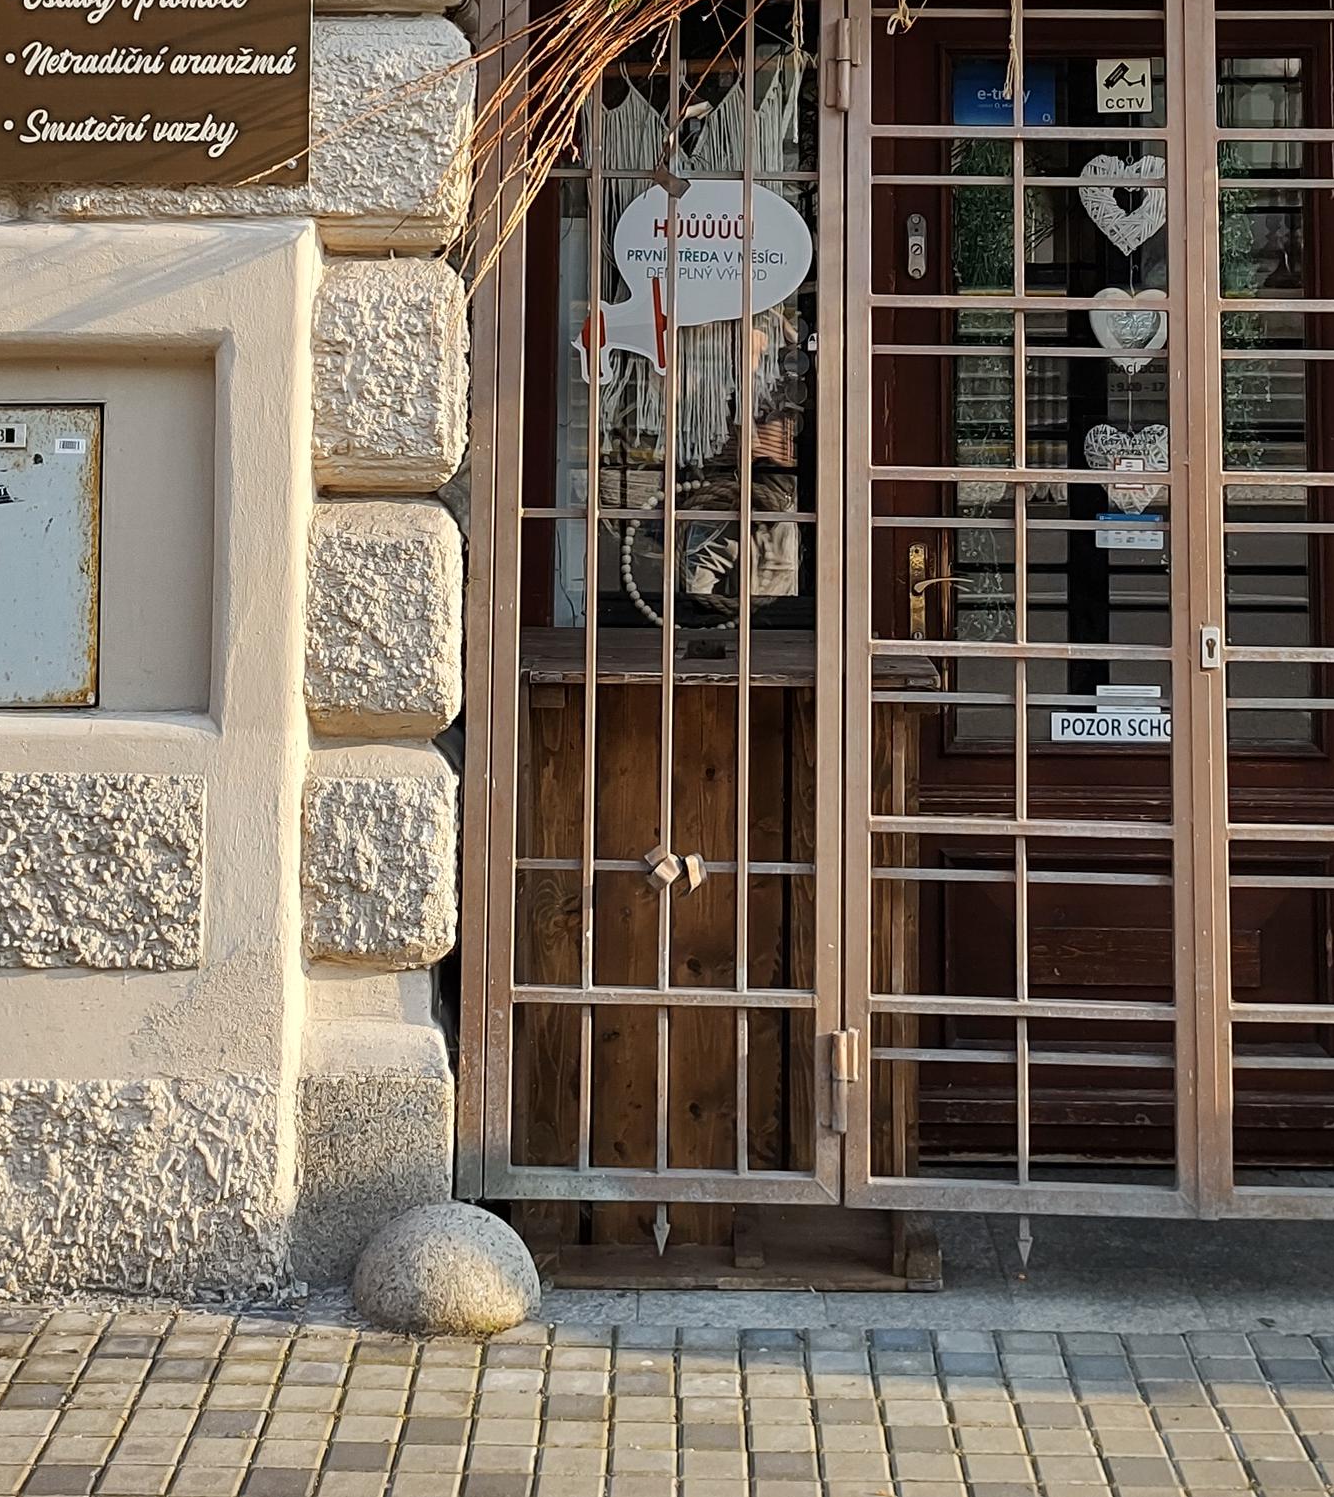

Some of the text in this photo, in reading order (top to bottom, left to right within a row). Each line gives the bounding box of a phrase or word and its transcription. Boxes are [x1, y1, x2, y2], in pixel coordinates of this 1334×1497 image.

[21, 41, 298, 76] Netradiční aranžmá
[977, 88, 1031, 103] e-try
[1105, 97, 1145, 109] CCTV
[19, 108, 239, 158] Smuteční vazby
[627, 247, 667, 262] PRVNÍ
[677, 247, 719, 262] TŘEDA
[723, 251, 733, 263] V
[679, 265, 713, 279] PLNÝ
[1061, 717, 1171, 736] POZOR SCHO
